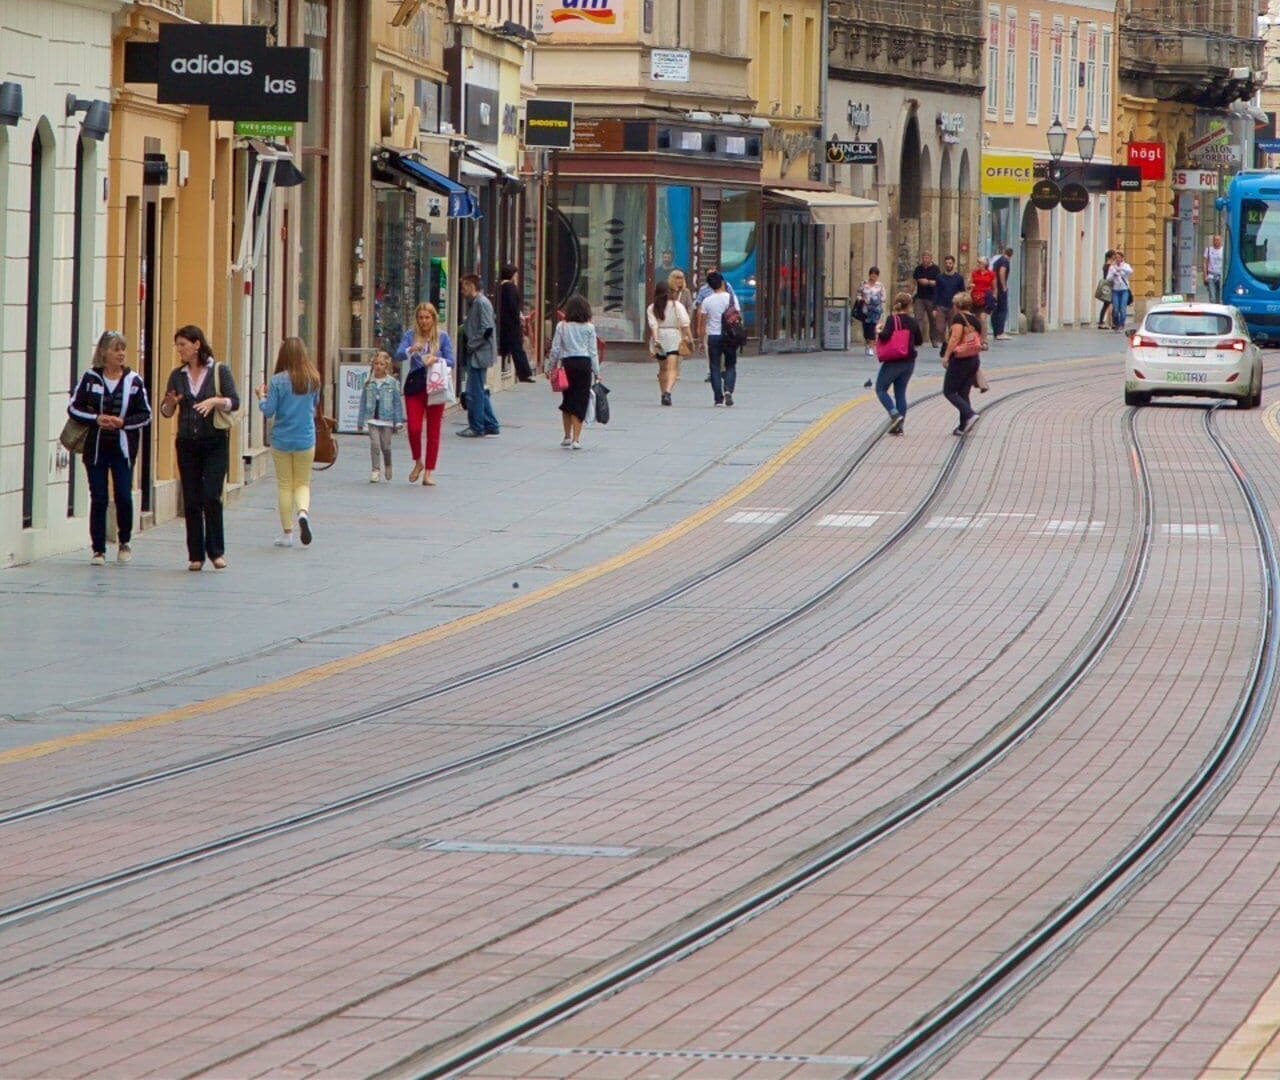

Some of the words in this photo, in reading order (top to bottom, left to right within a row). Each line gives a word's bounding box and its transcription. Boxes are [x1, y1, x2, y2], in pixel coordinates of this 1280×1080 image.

[171, 54, 253, 75] adidas
[1130, 147, 1162, 161] högl
[986, 167, 1030, 178] OFFICE
